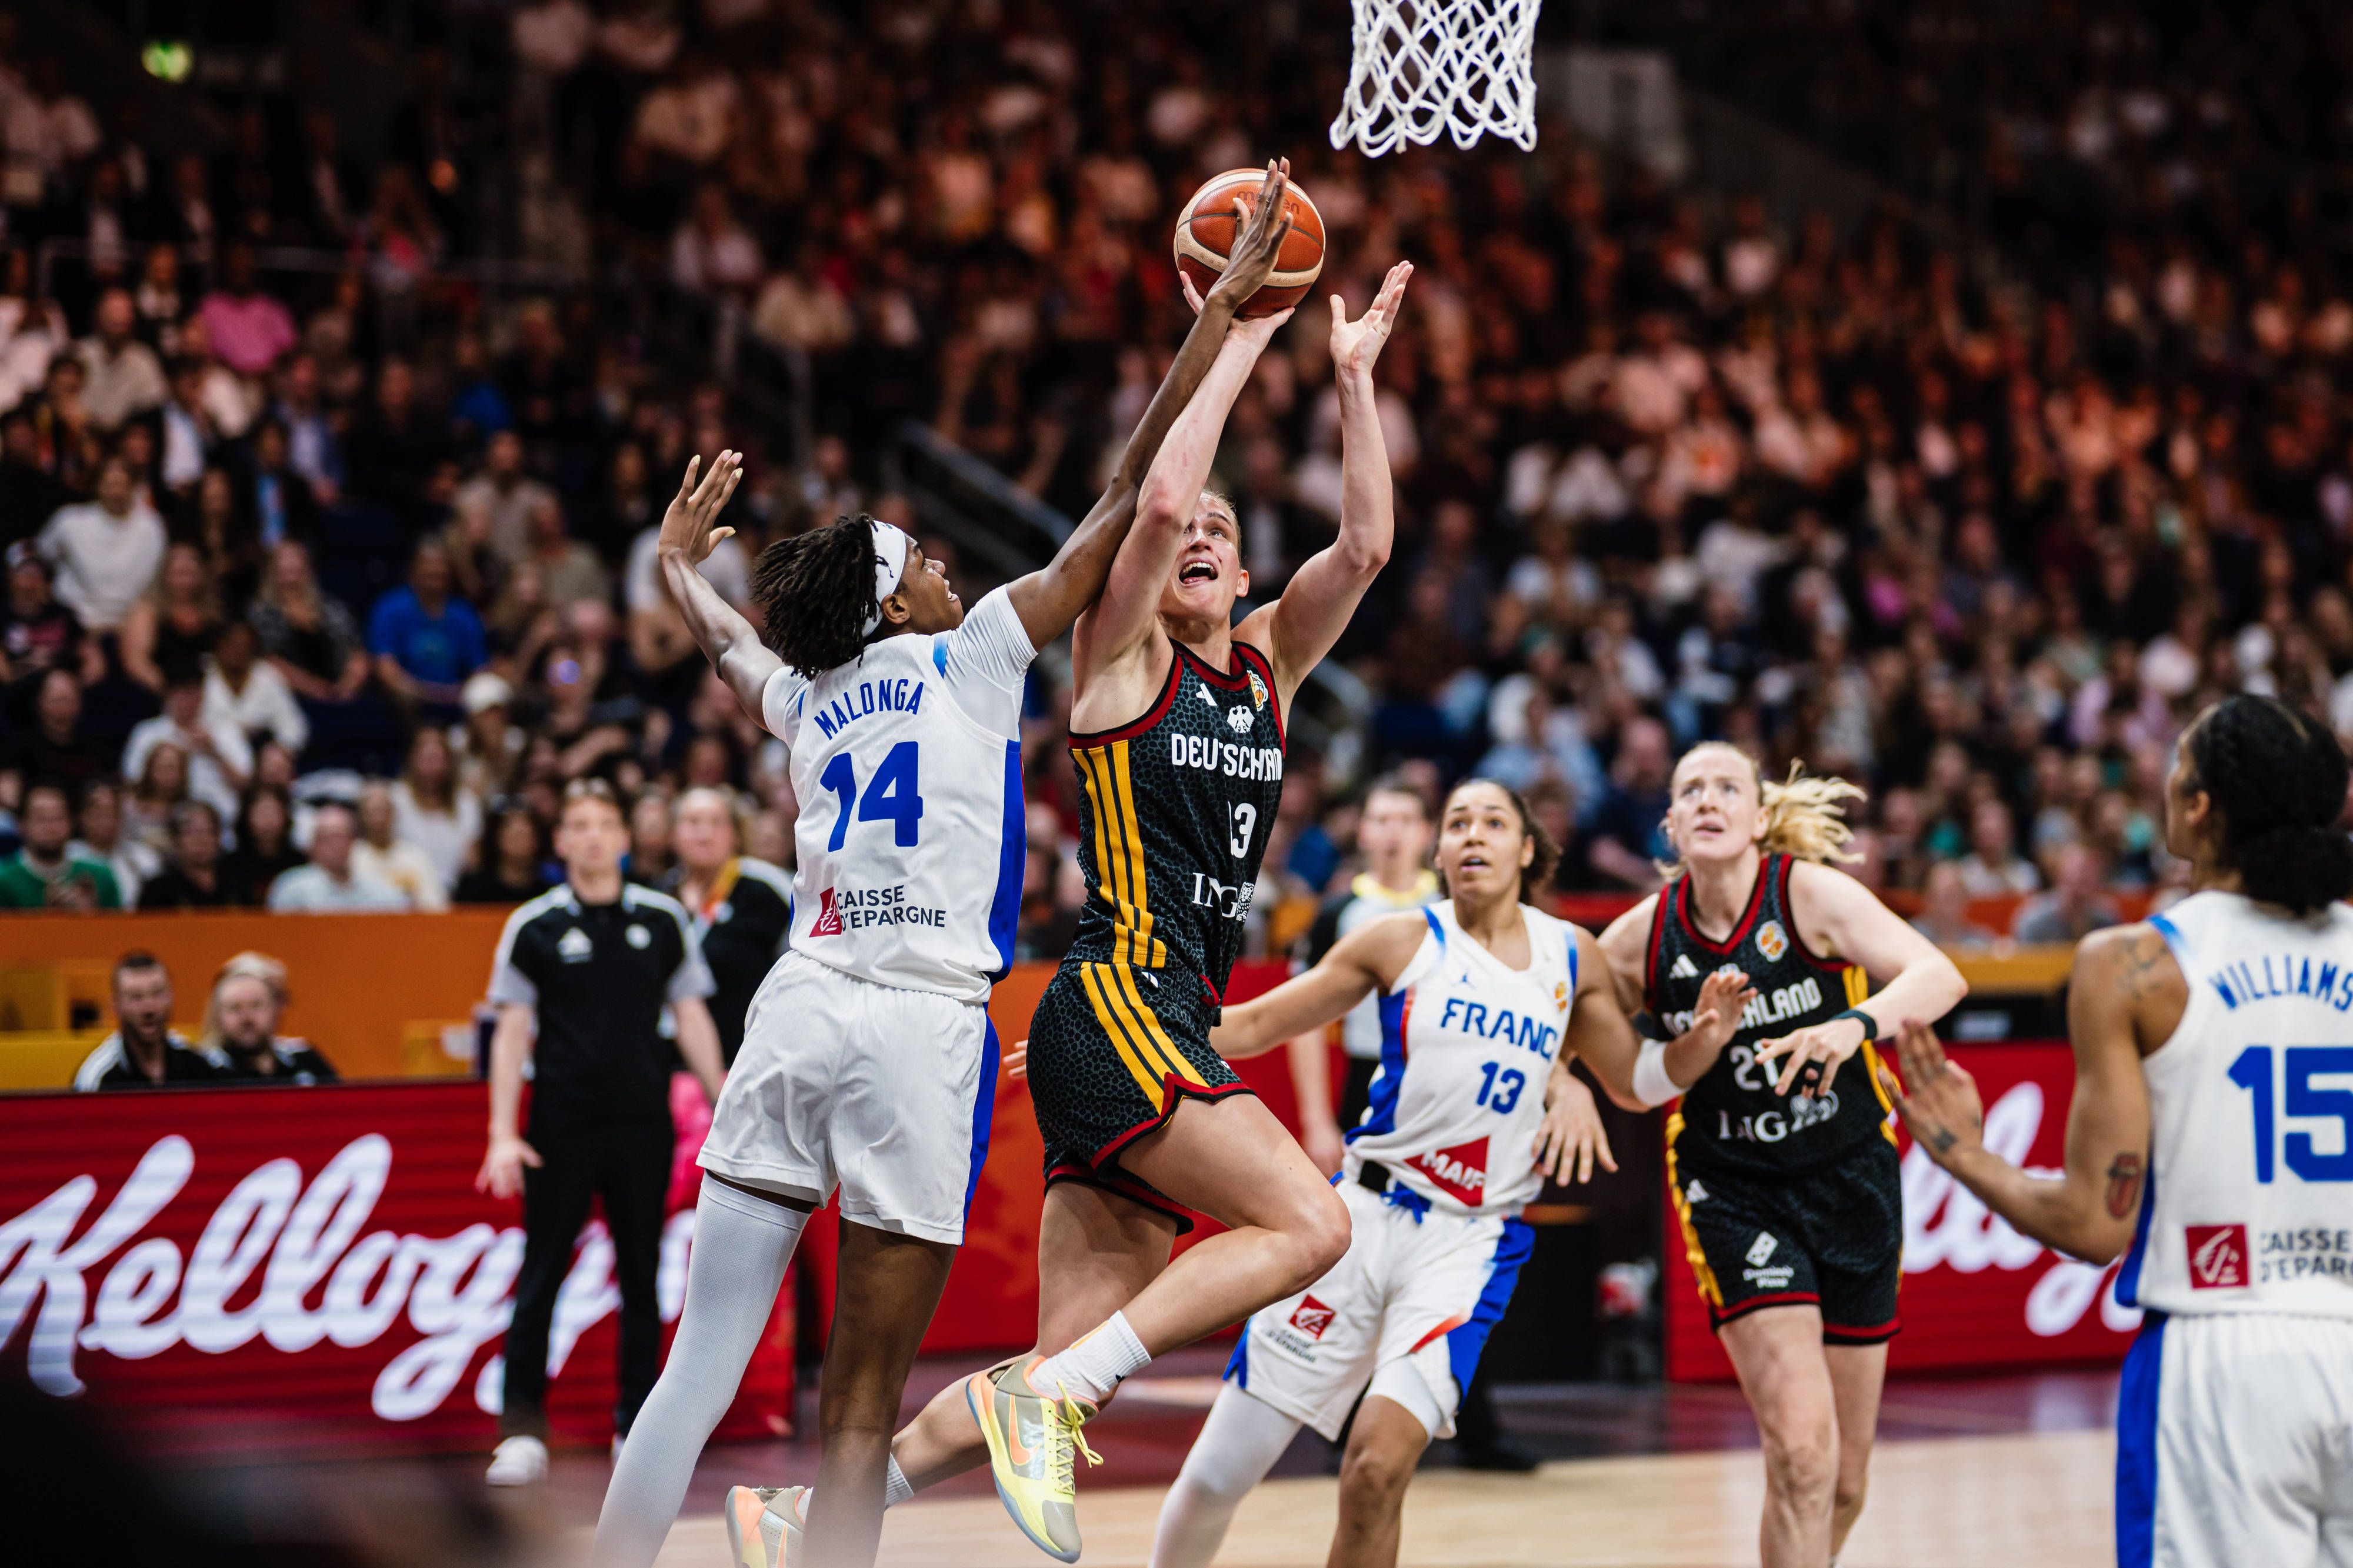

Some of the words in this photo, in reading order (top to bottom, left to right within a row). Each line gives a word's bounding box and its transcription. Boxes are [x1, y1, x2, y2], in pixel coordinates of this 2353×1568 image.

[814, 679, 924, 740] MALONGA
[819, 741, 923, 853] 14
[836, 885, 905, 910] CAISSE
[1192, 872, 1238, 918] ING
[2207, 952, 2353, 1012] WILLIAMS
[1476, 1060, 1525, 1114] 13
[2227, 1045, 2353, 1183] 15
[1421, 1150, 1487, 1191] MAIF
